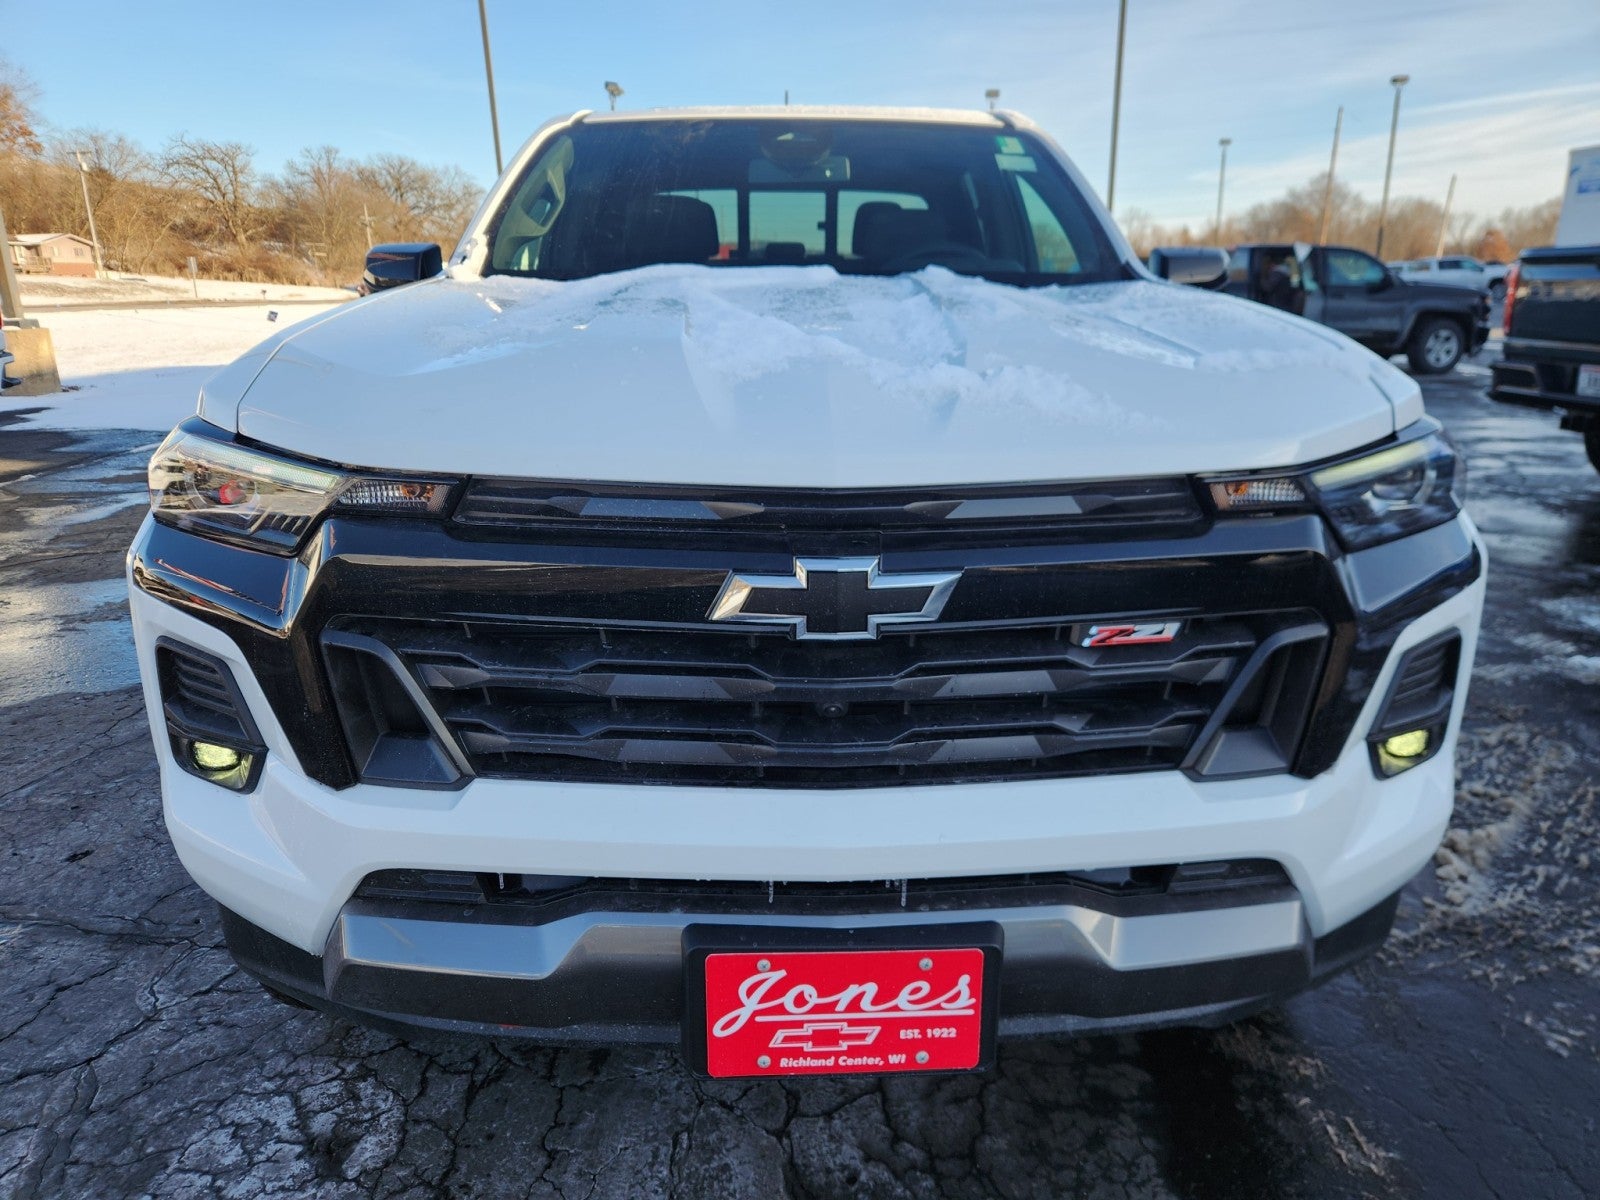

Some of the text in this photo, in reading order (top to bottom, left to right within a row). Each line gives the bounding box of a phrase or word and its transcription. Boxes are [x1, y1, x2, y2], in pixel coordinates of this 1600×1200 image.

[712, 969, 977, 1038] Jones
[899, 1027, 957, 1039] EST. 1922
[779, 1053, 907, 1067] Richland Center, WI
